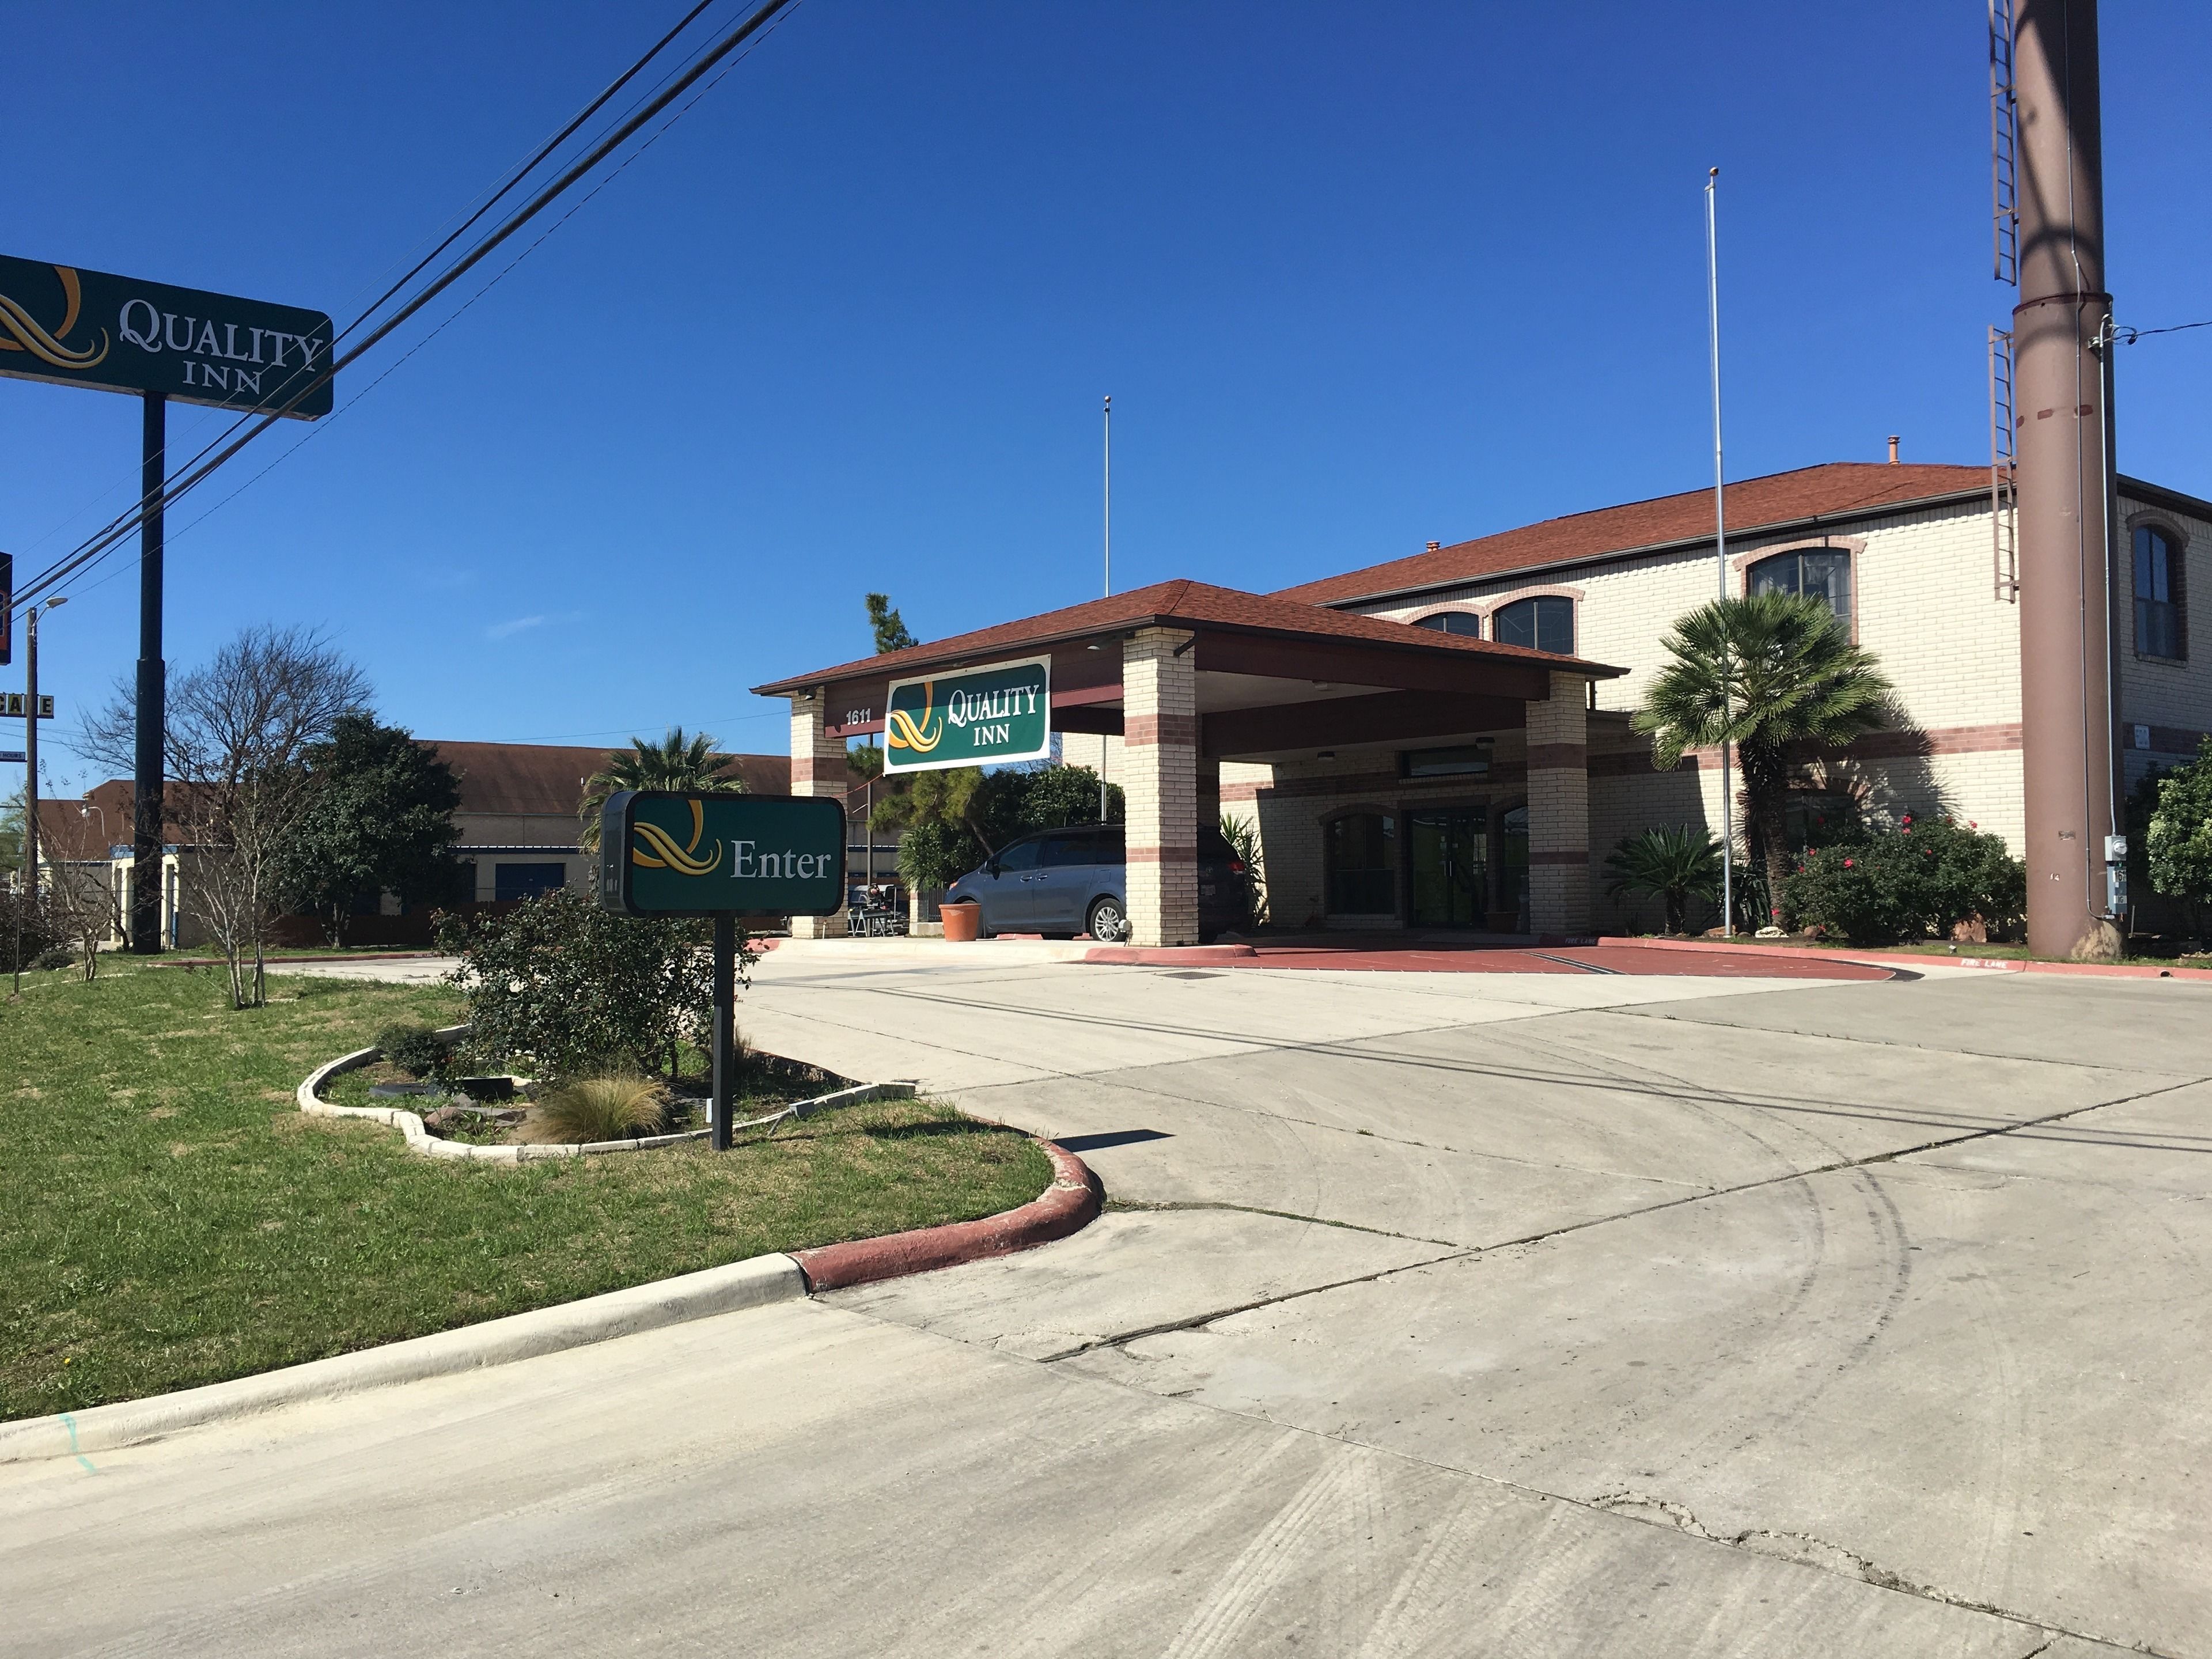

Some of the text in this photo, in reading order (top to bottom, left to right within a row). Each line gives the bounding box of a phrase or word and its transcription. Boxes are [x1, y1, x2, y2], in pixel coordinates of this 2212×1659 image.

[119, 299, 323, 372] QUALITY
[183, 361, 262, 395] INN
[846, 708, 871, 725] 1611
[948, 684, 1040, 728] QUALITY
[974, 724, 1010, 747] INN
[730, 840, 831, 878] Enter
[1960, 958, 2009, 968] FIRE LANE
